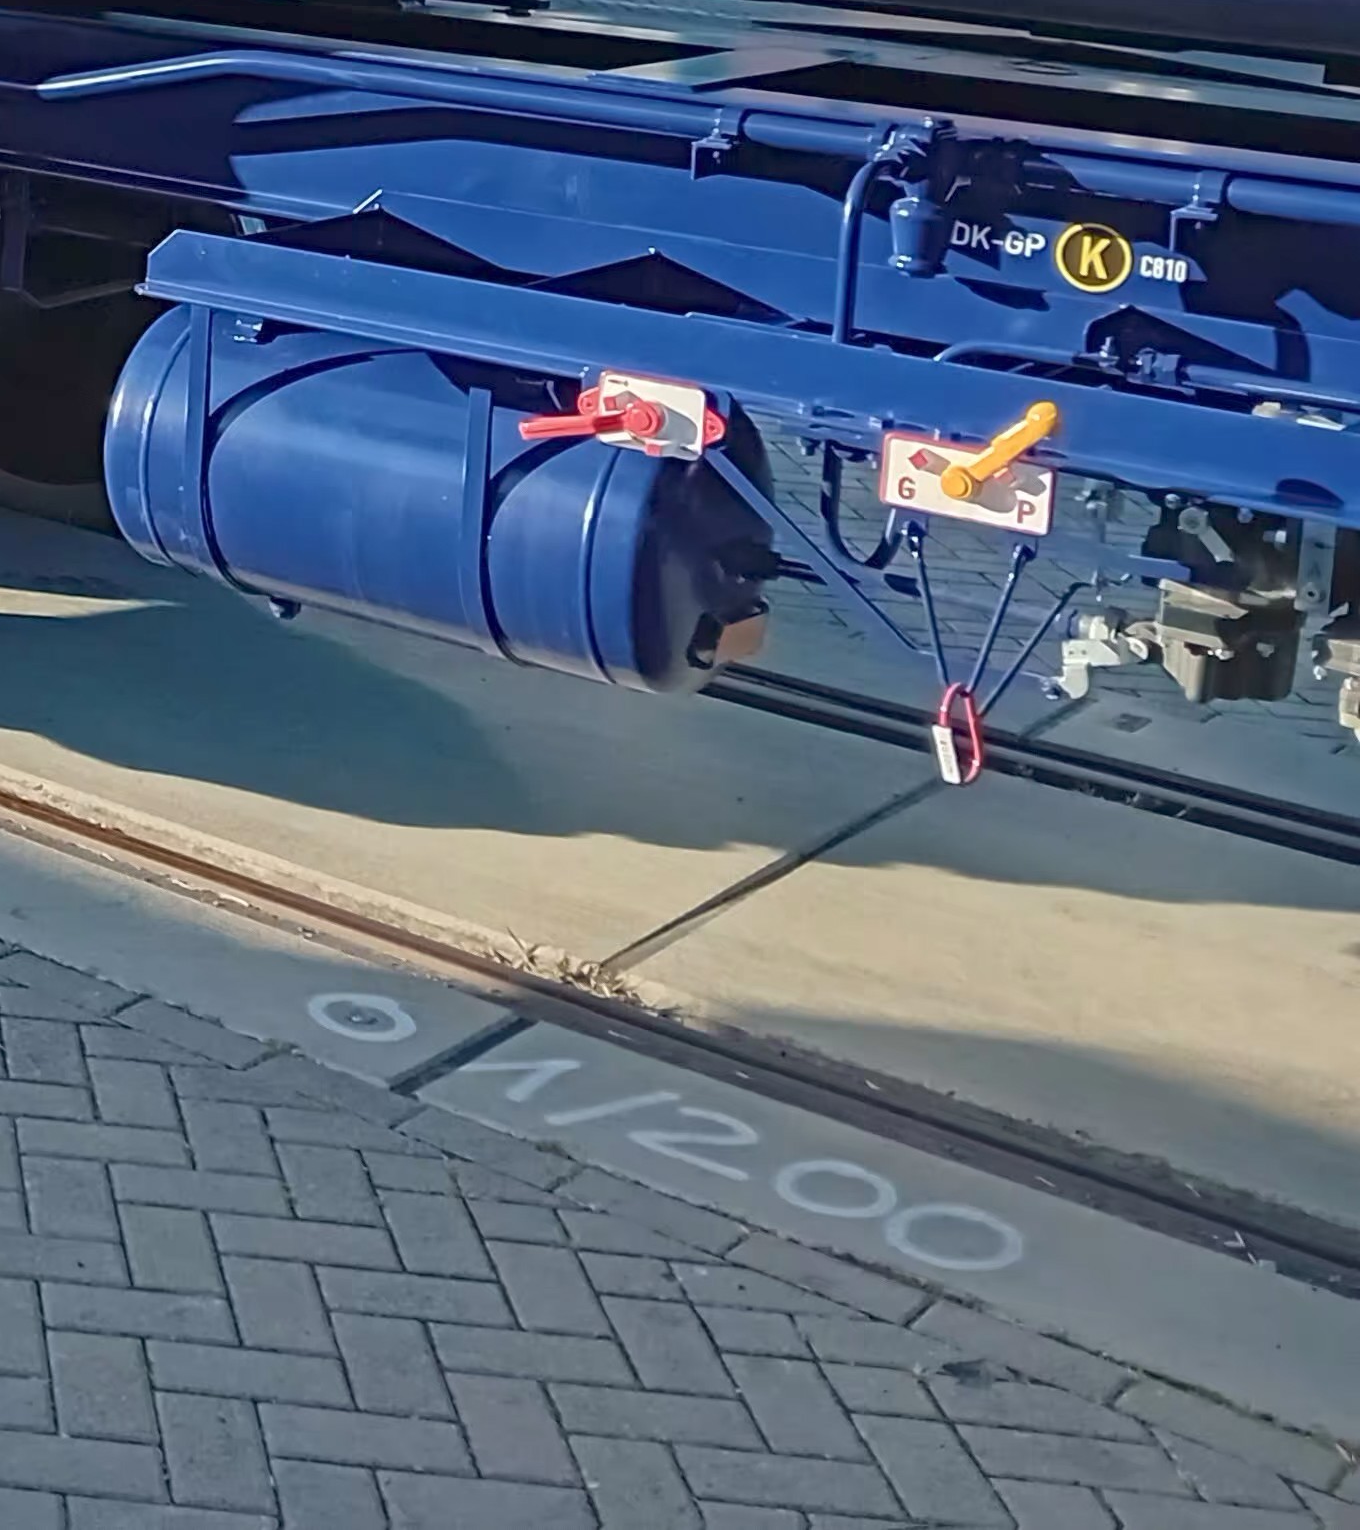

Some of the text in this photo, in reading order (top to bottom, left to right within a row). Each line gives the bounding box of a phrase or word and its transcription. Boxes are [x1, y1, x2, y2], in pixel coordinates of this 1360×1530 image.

[950, 219, 1047, 258] DK-GP
[1079, 234, 1114, 280] K
[897, 475, 917, 502] G
[1015, 498, 1037, 525] P
